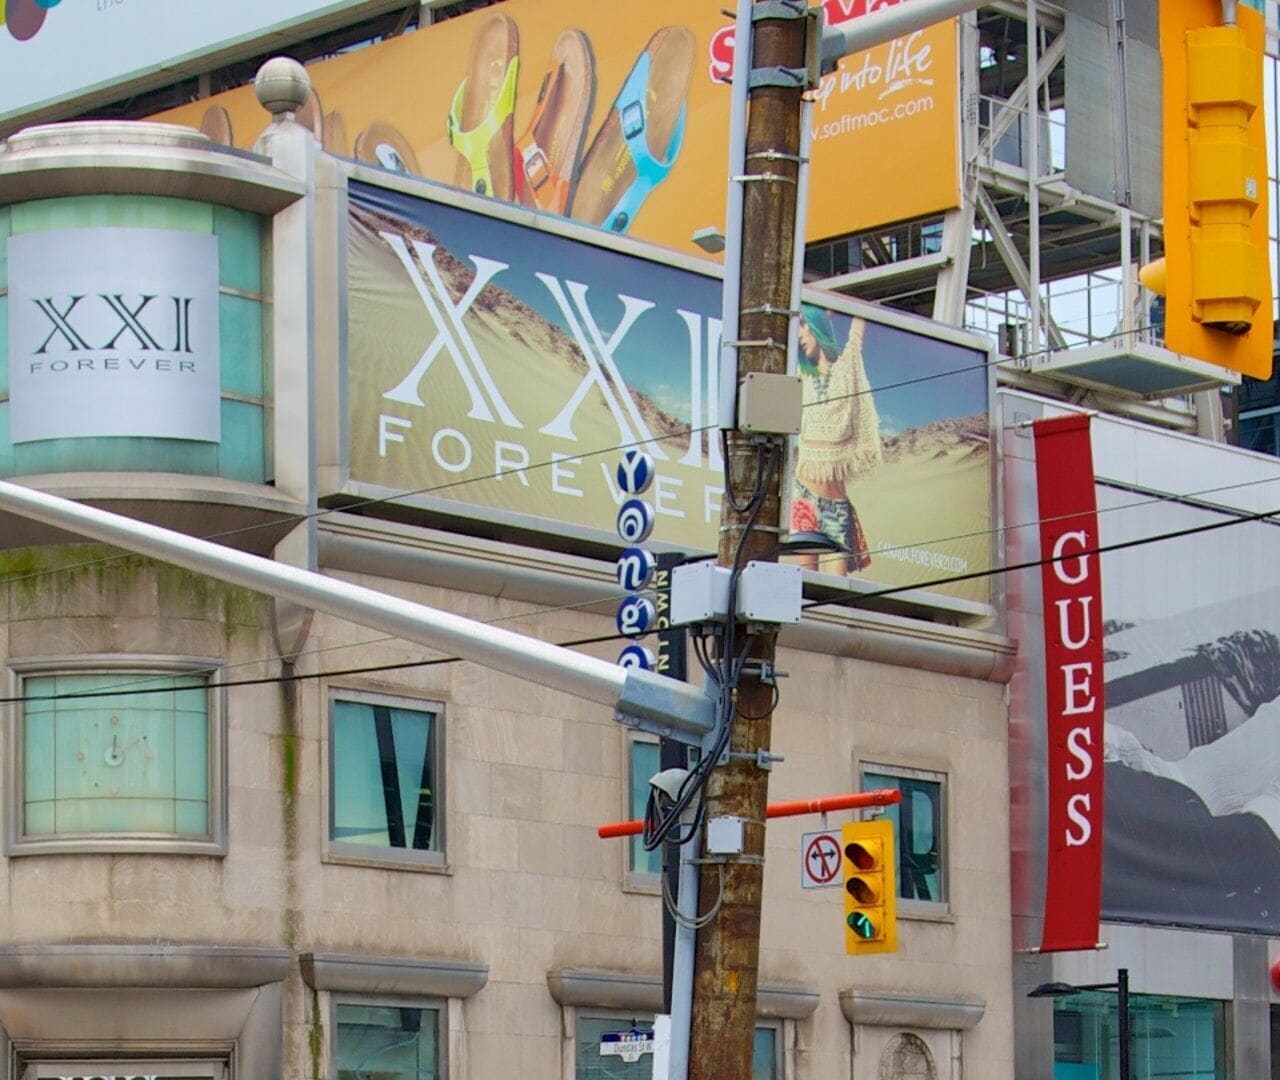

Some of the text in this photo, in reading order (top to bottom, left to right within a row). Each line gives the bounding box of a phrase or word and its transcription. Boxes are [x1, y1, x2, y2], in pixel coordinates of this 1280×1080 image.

[840, 30, 933, 94] into life
[31, 293, 195, 355] XXI
[379, 231, 723, 470] XXI
[29, 357, 198, 375] FOREVER
[1051, 530, 1096, 848] GUESS
